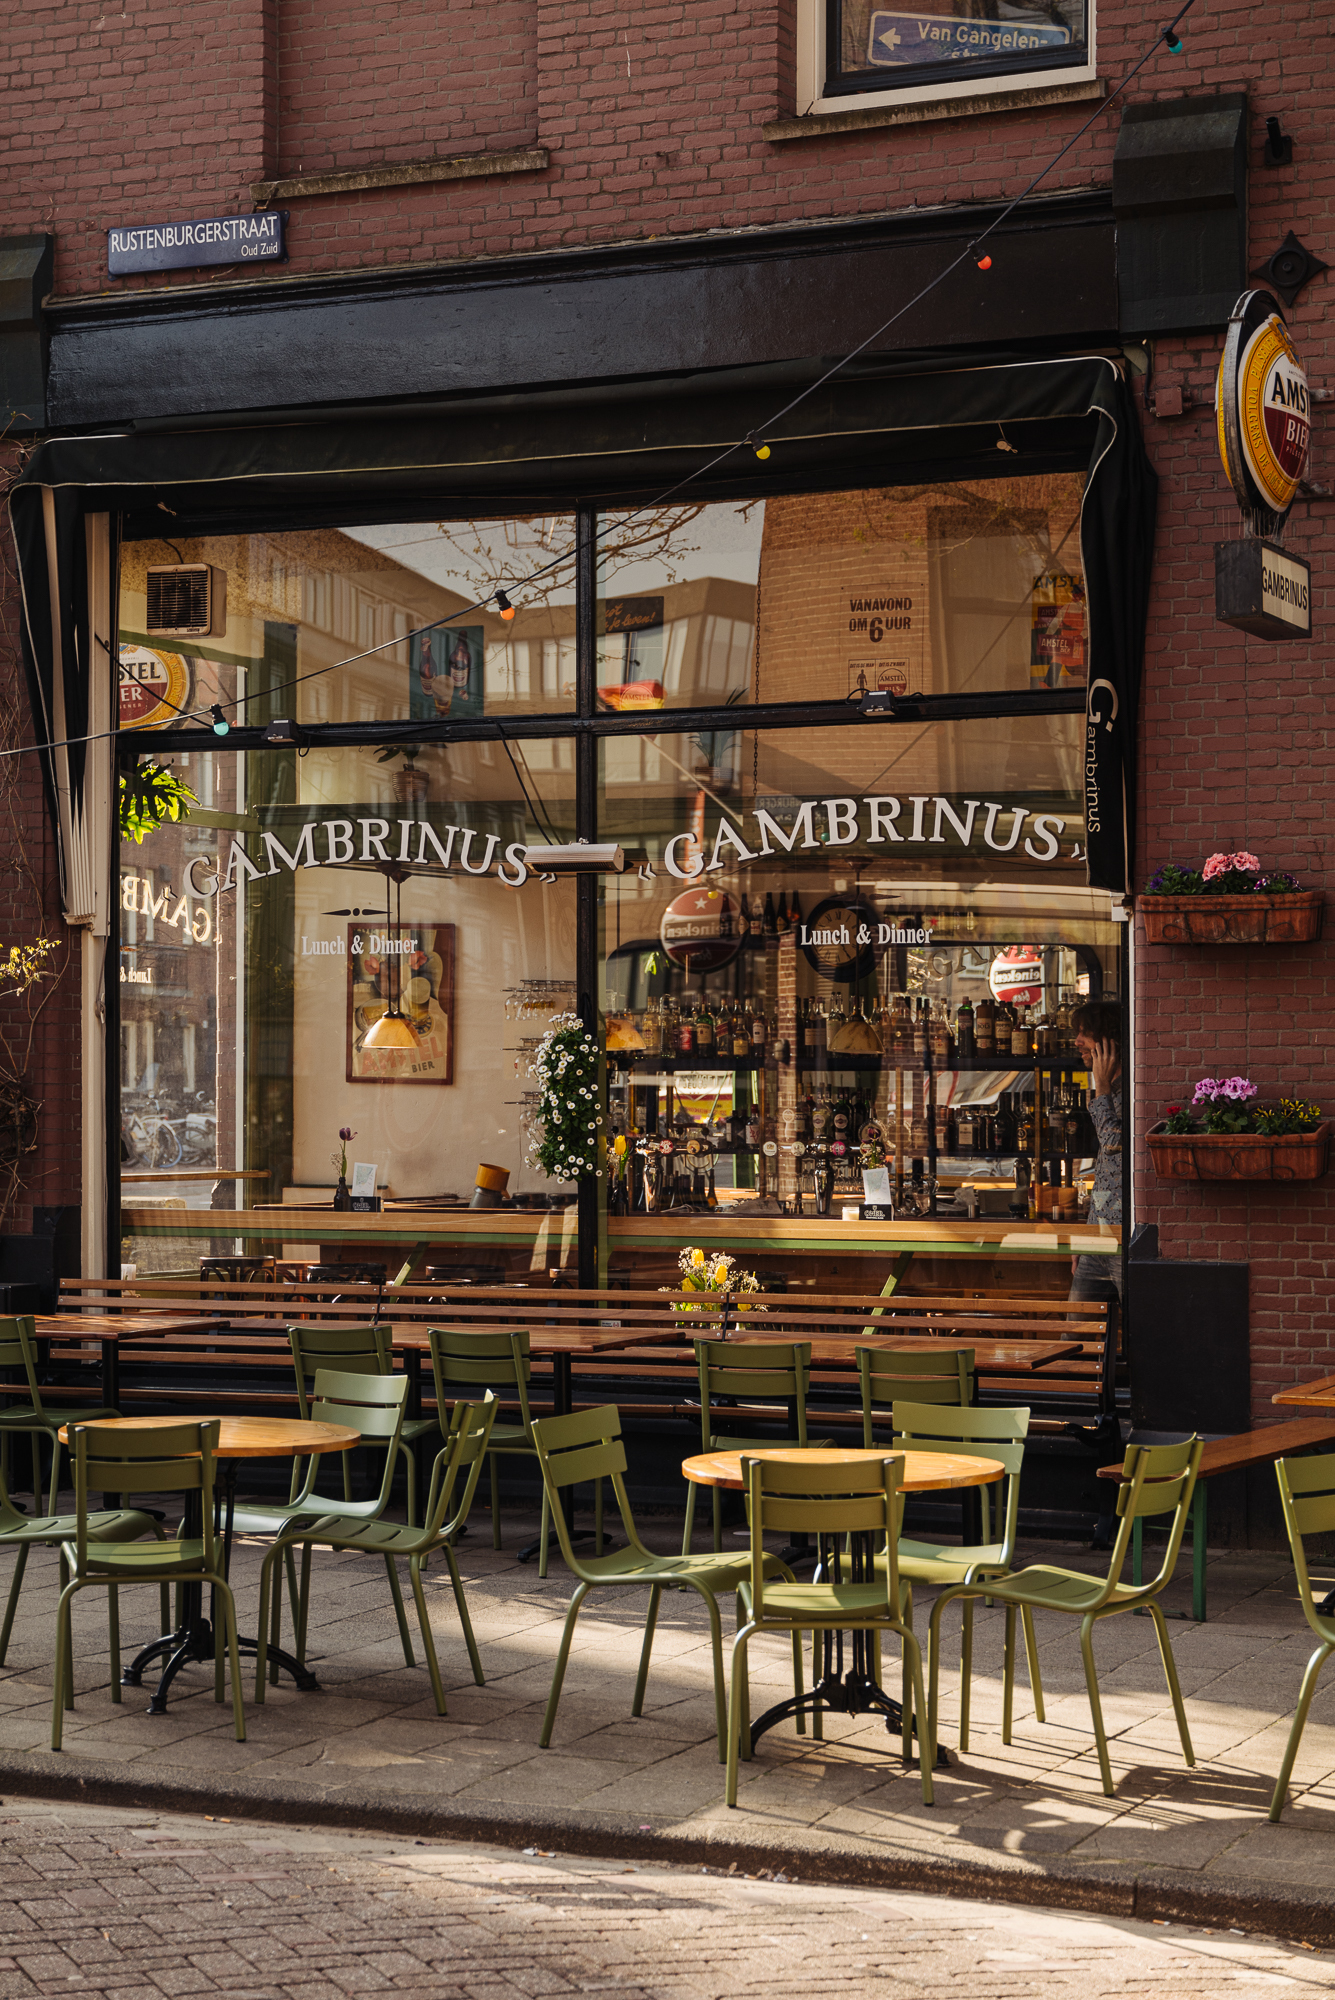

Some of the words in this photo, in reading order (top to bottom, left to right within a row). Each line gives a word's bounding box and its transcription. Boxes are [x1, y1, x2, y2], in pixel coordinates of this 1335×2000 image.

[918, 21, 950, 42] Van
[957, 25, 1048, 51] Gangelen-
[111, 216, 277, 253] RUSTENBURGERSTRAAT
[241, 244, 257, 257] Oud
[261, 242, 278, 255] Zuid
[1262, 566, 1307, 611] GAMBRINUS
[850, 597, 912, 612] VANAVOND
[849, 617, 868, 632] OM
[869, 616, 884, 643] 6
[885, 616, 911, 631] UUR
[1041, 638, 1068, 648] AMSTEL
[1085, 678, 1119, 833] Gambrinus
[301, 935, 346, 956] Lunch
[351, 934, 365, 956] &
[369, 934, 418, 955] Dinner
[800, 924, 850, 946] Lunch
[856, 923, 872, 945] &
[877, 923, 934, 945] Dinner
[361, 1036, 444, 1075] AMSTEL
[411, 1061, 435, 1073] BIER
